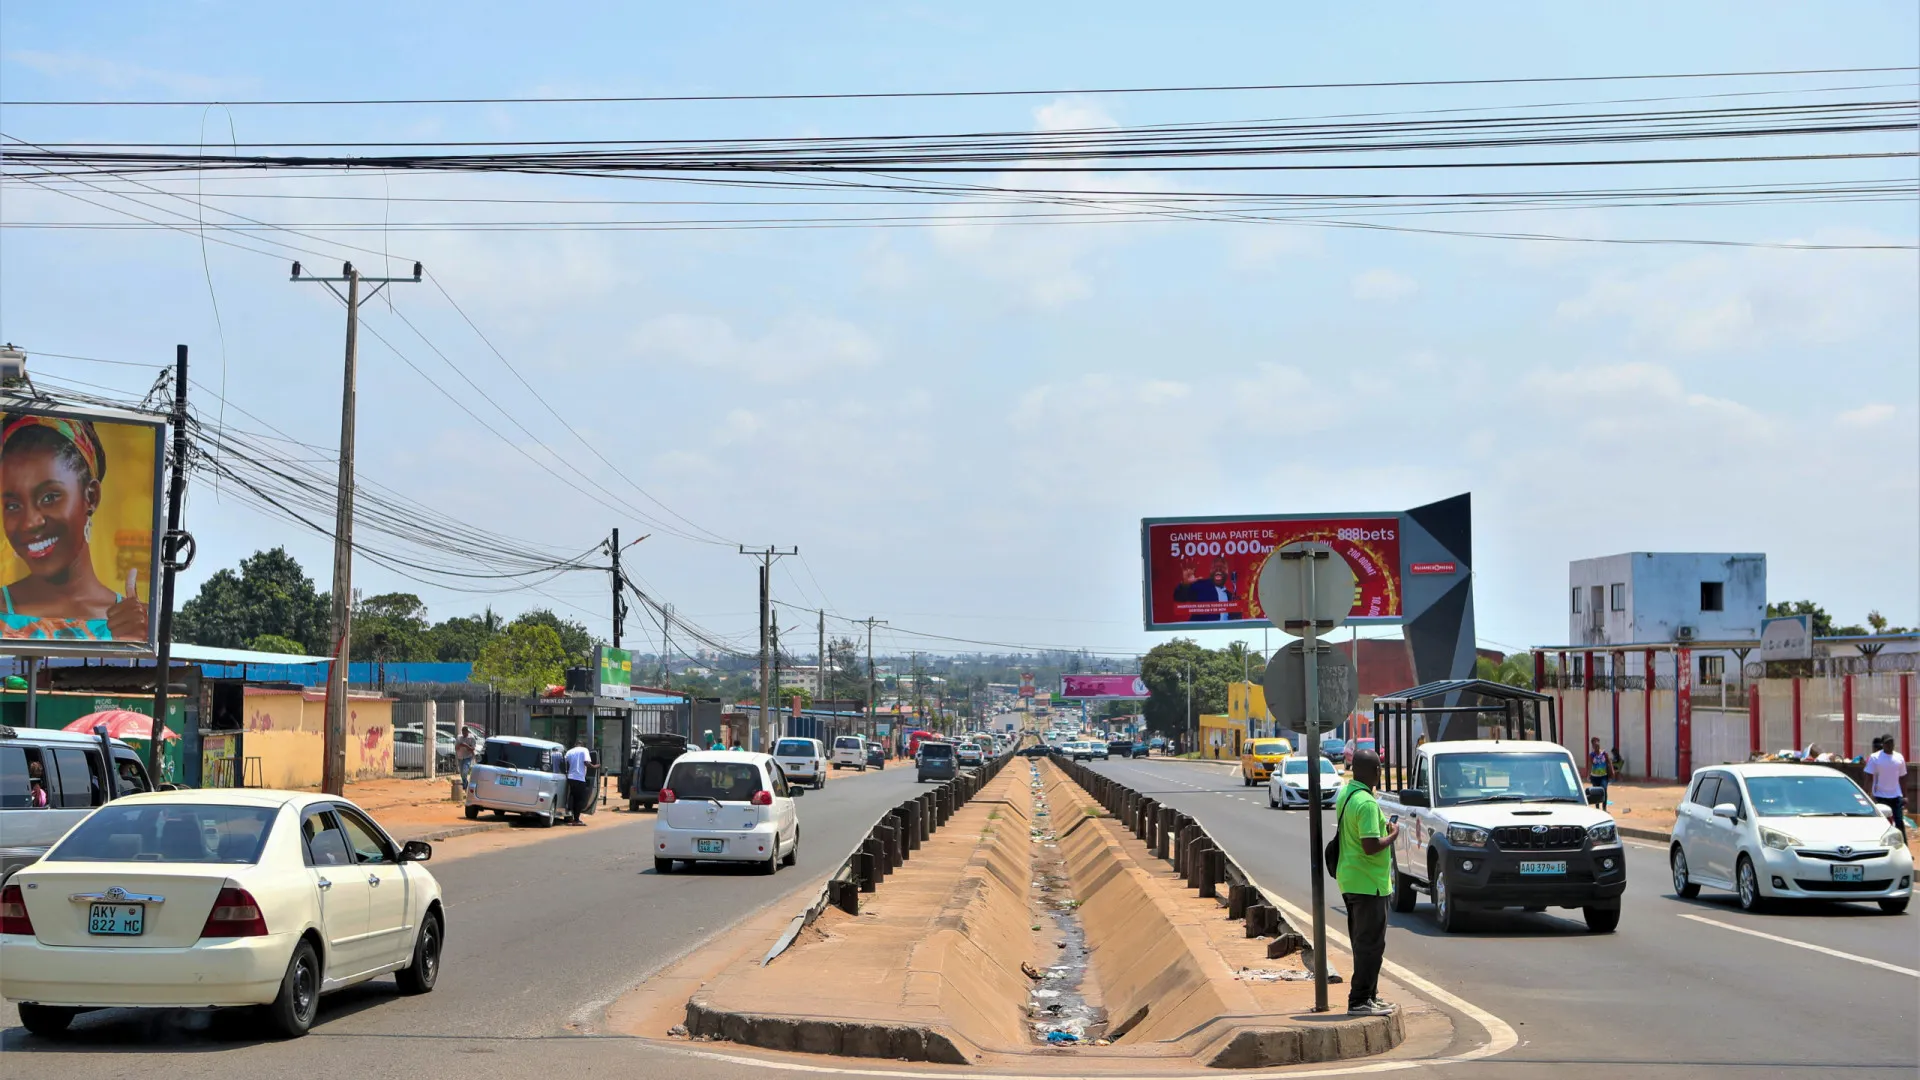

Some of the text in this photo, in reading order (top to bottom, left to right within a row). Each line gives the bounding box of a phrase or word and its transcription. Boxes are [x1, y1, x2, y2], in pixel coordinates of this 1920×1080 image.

[1170, 529, 1274, 541] GANHE UMA PARTE DE
[1338, 528, 1395, 541] 888bets
[1171, 540, 1275, 559] 5,000,000MT
[1536, 863, 1551, 872] 379
[1557, 863, 1566, 872] IB
[92, 906, 117, 918] AKY
[91, 920, 140, 932] 822 MC
